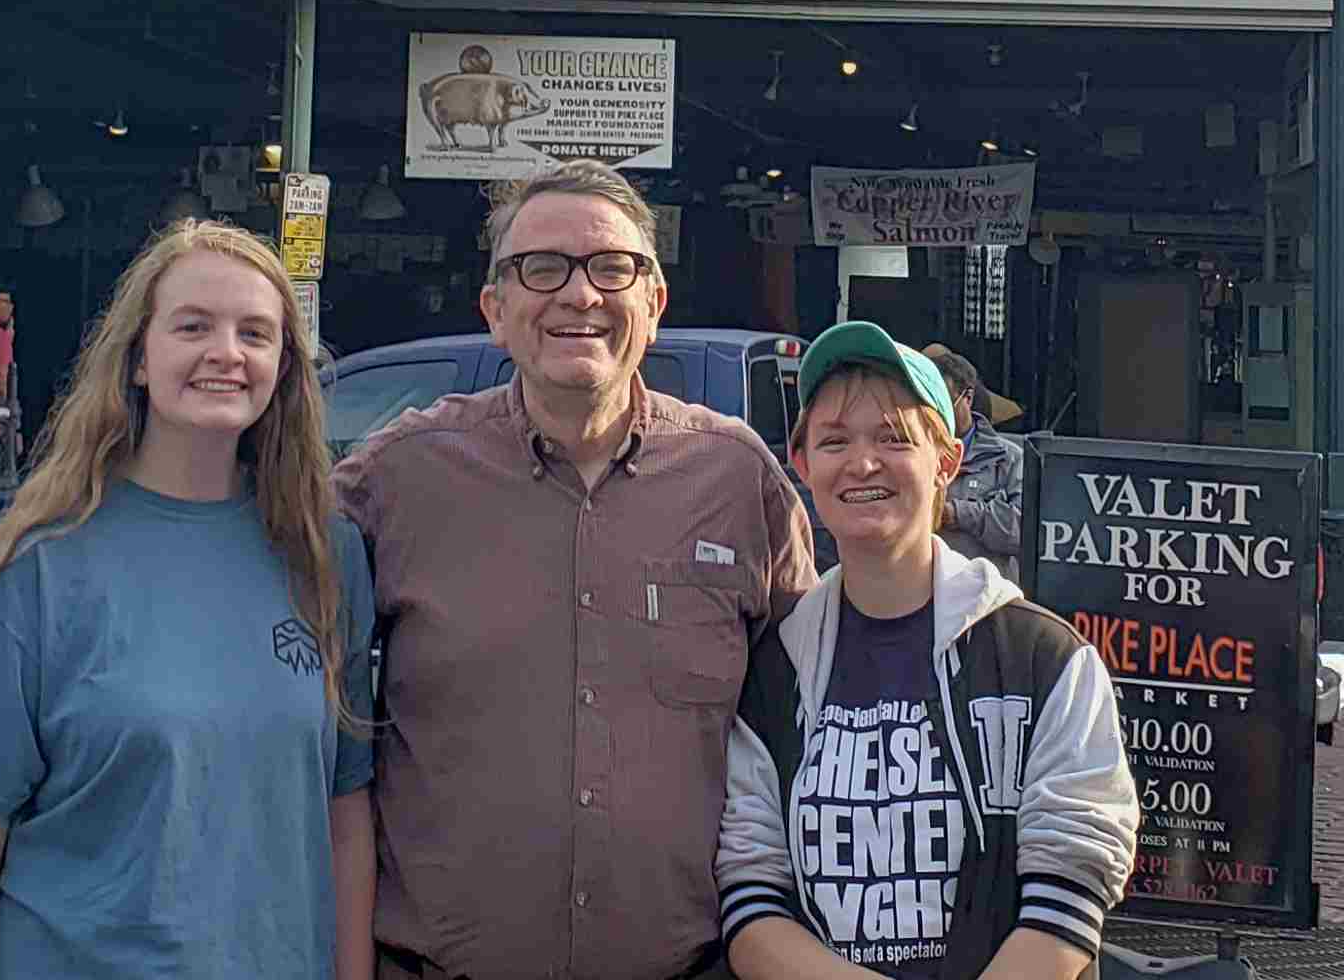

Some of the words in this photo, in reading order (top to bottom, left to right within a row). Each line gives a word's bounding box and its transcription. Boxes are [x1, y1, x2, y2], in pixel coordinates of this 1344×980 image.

[517, 50, 576, 77] YOUR
[579, 51, 668, 80] CHANGE
[541, 79, 614, 92] CHANGES
[618, 80, 667, 93] LIVES!
[553, 109, 598, 118] SUPPORTS
[559, 98, 590, 108] YOUR
[592, 99, 666, 110] GENEROSITY
[546, 119, 593, 129] MARKET
[594, 120, 665, 131] FOUNDATION
[541, 143, 597, 157] DONATE
[599, 145, 640, 158] HERE!
[872, 219, 976, 243] Salmon
[1077, 473, 1261, 526] VALET
[1040, 520, 1295, 580] PARKING
[1123, 572, 1206, 606] FOR
[1074, 611, 1140, 672] PIKE
[1150, 623, 1254, 683] PLACE
[1114, 686, 1248, 711] ARKET
[1145, 754, 1216, 772] VALIDATION
[1155, 817, 1227, 833] VALIDATION
[1175, 837, 1190, 850] AT
[1211, 839, 1232, 854] PM
[1203, 860, 1280, 886] VALET
[851, 942, 862, 964] is
